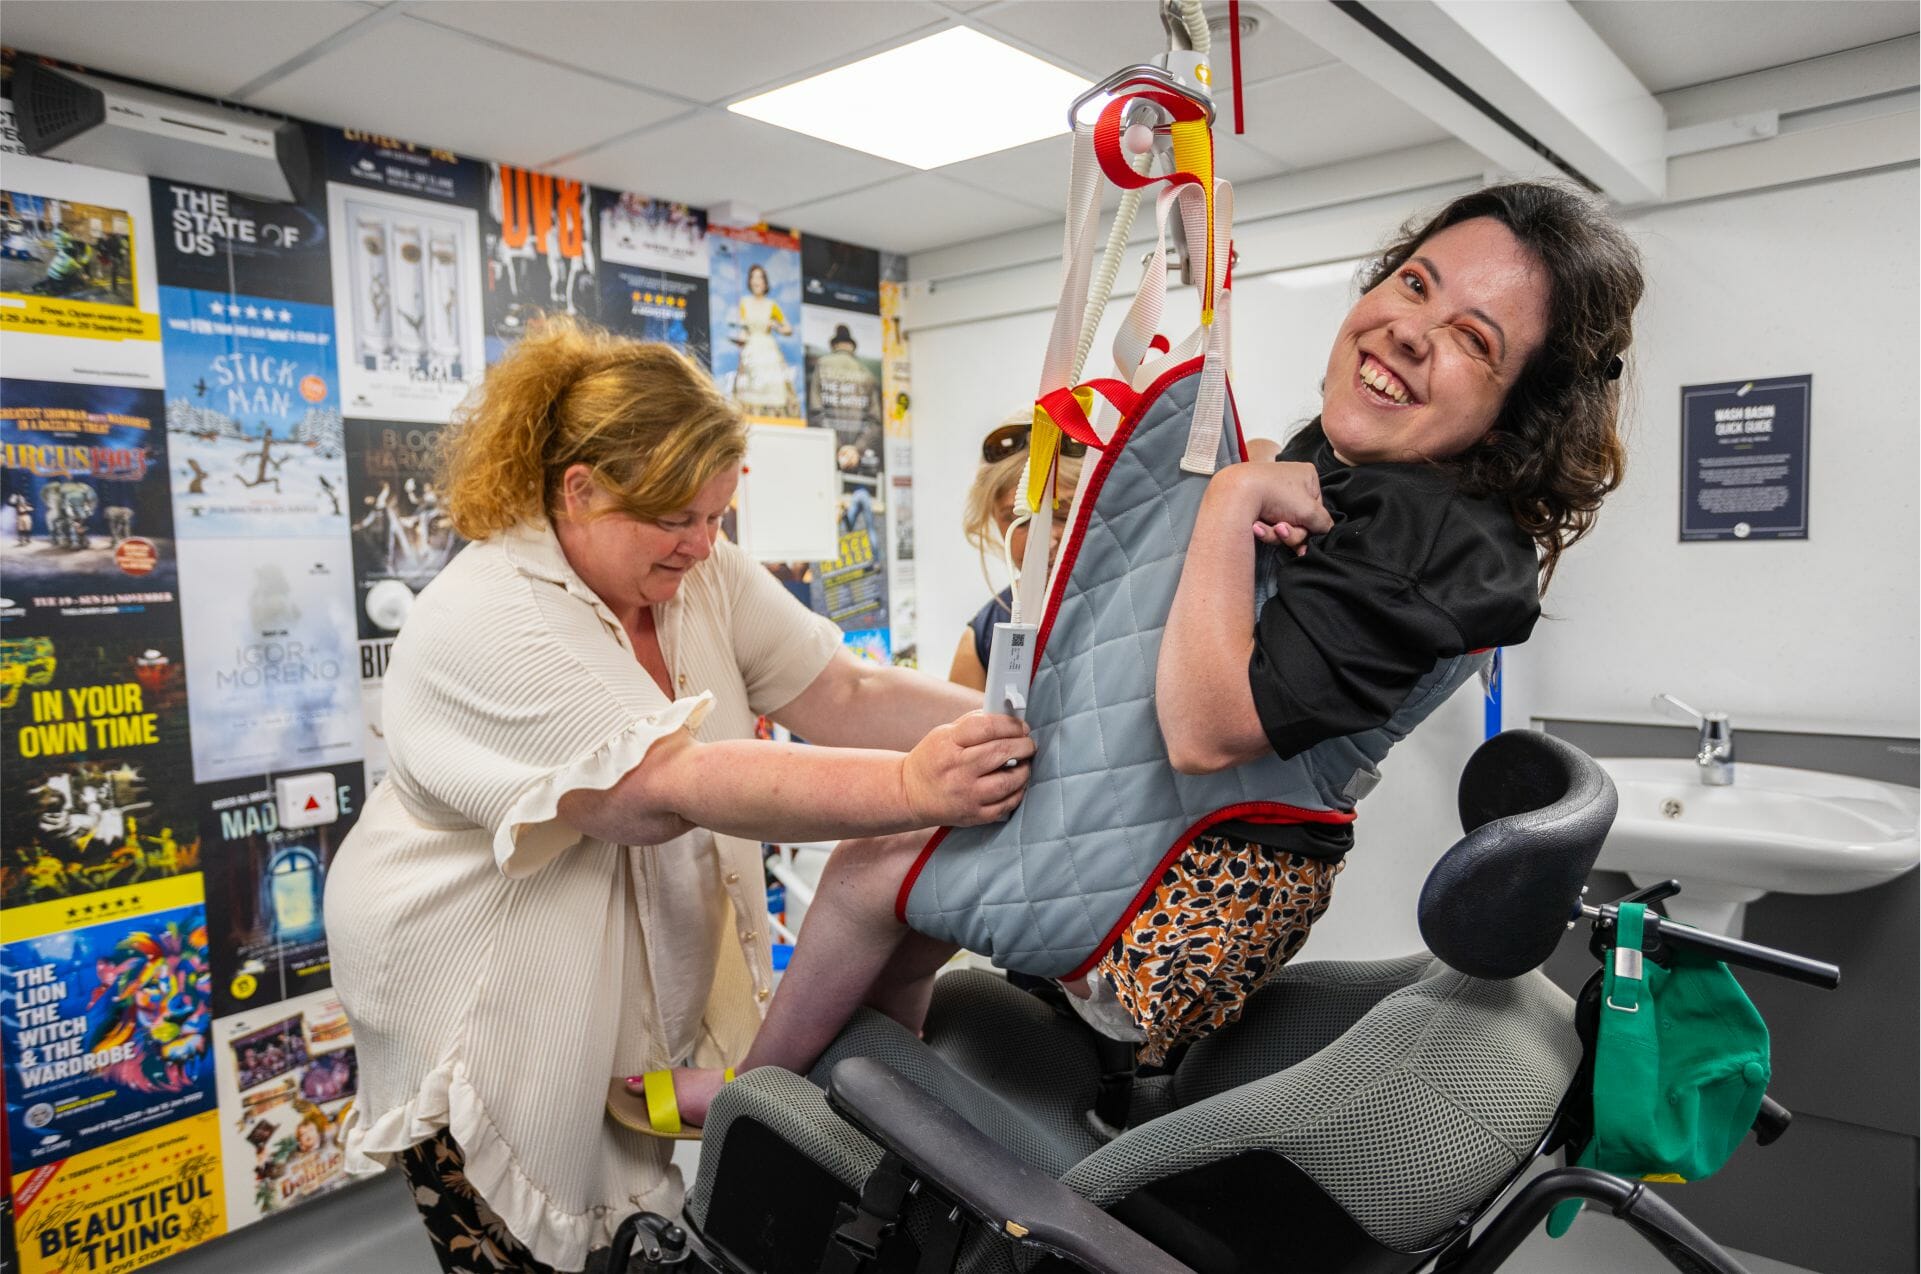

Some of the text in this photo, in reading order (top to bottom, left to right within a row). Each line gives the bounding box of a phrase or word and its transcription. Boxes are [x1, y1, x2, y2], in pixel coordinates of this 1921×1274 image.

[170, 185, 229, 218] THE
[172, 209, 300, 248] STATE OF
[174, 230, 216, 256] US
[210, 352, 298, 388] STICK
[227, 384, 290, 418] MAN
[216, 659, 340, 690] MORENO
[32, 682, 143, 723] IN YOUR
[19, 713, 160, 758] OWN TIME
[13, 963, 57, 989] THE
[15, 981, 67, 1009] LION
[16, 1002, 60, 1029] THE
[17, 1016, 87, 1049] WITCH
[21, 1036, 84, 1068] & THE
[21, 1041, 136, 1089] WARDROBE
[39, 1174, 212, 1258] BEAUTIFUL
[81, 1213, 182, 1271] THING
[138, 1245, 172, 1265] STORY
